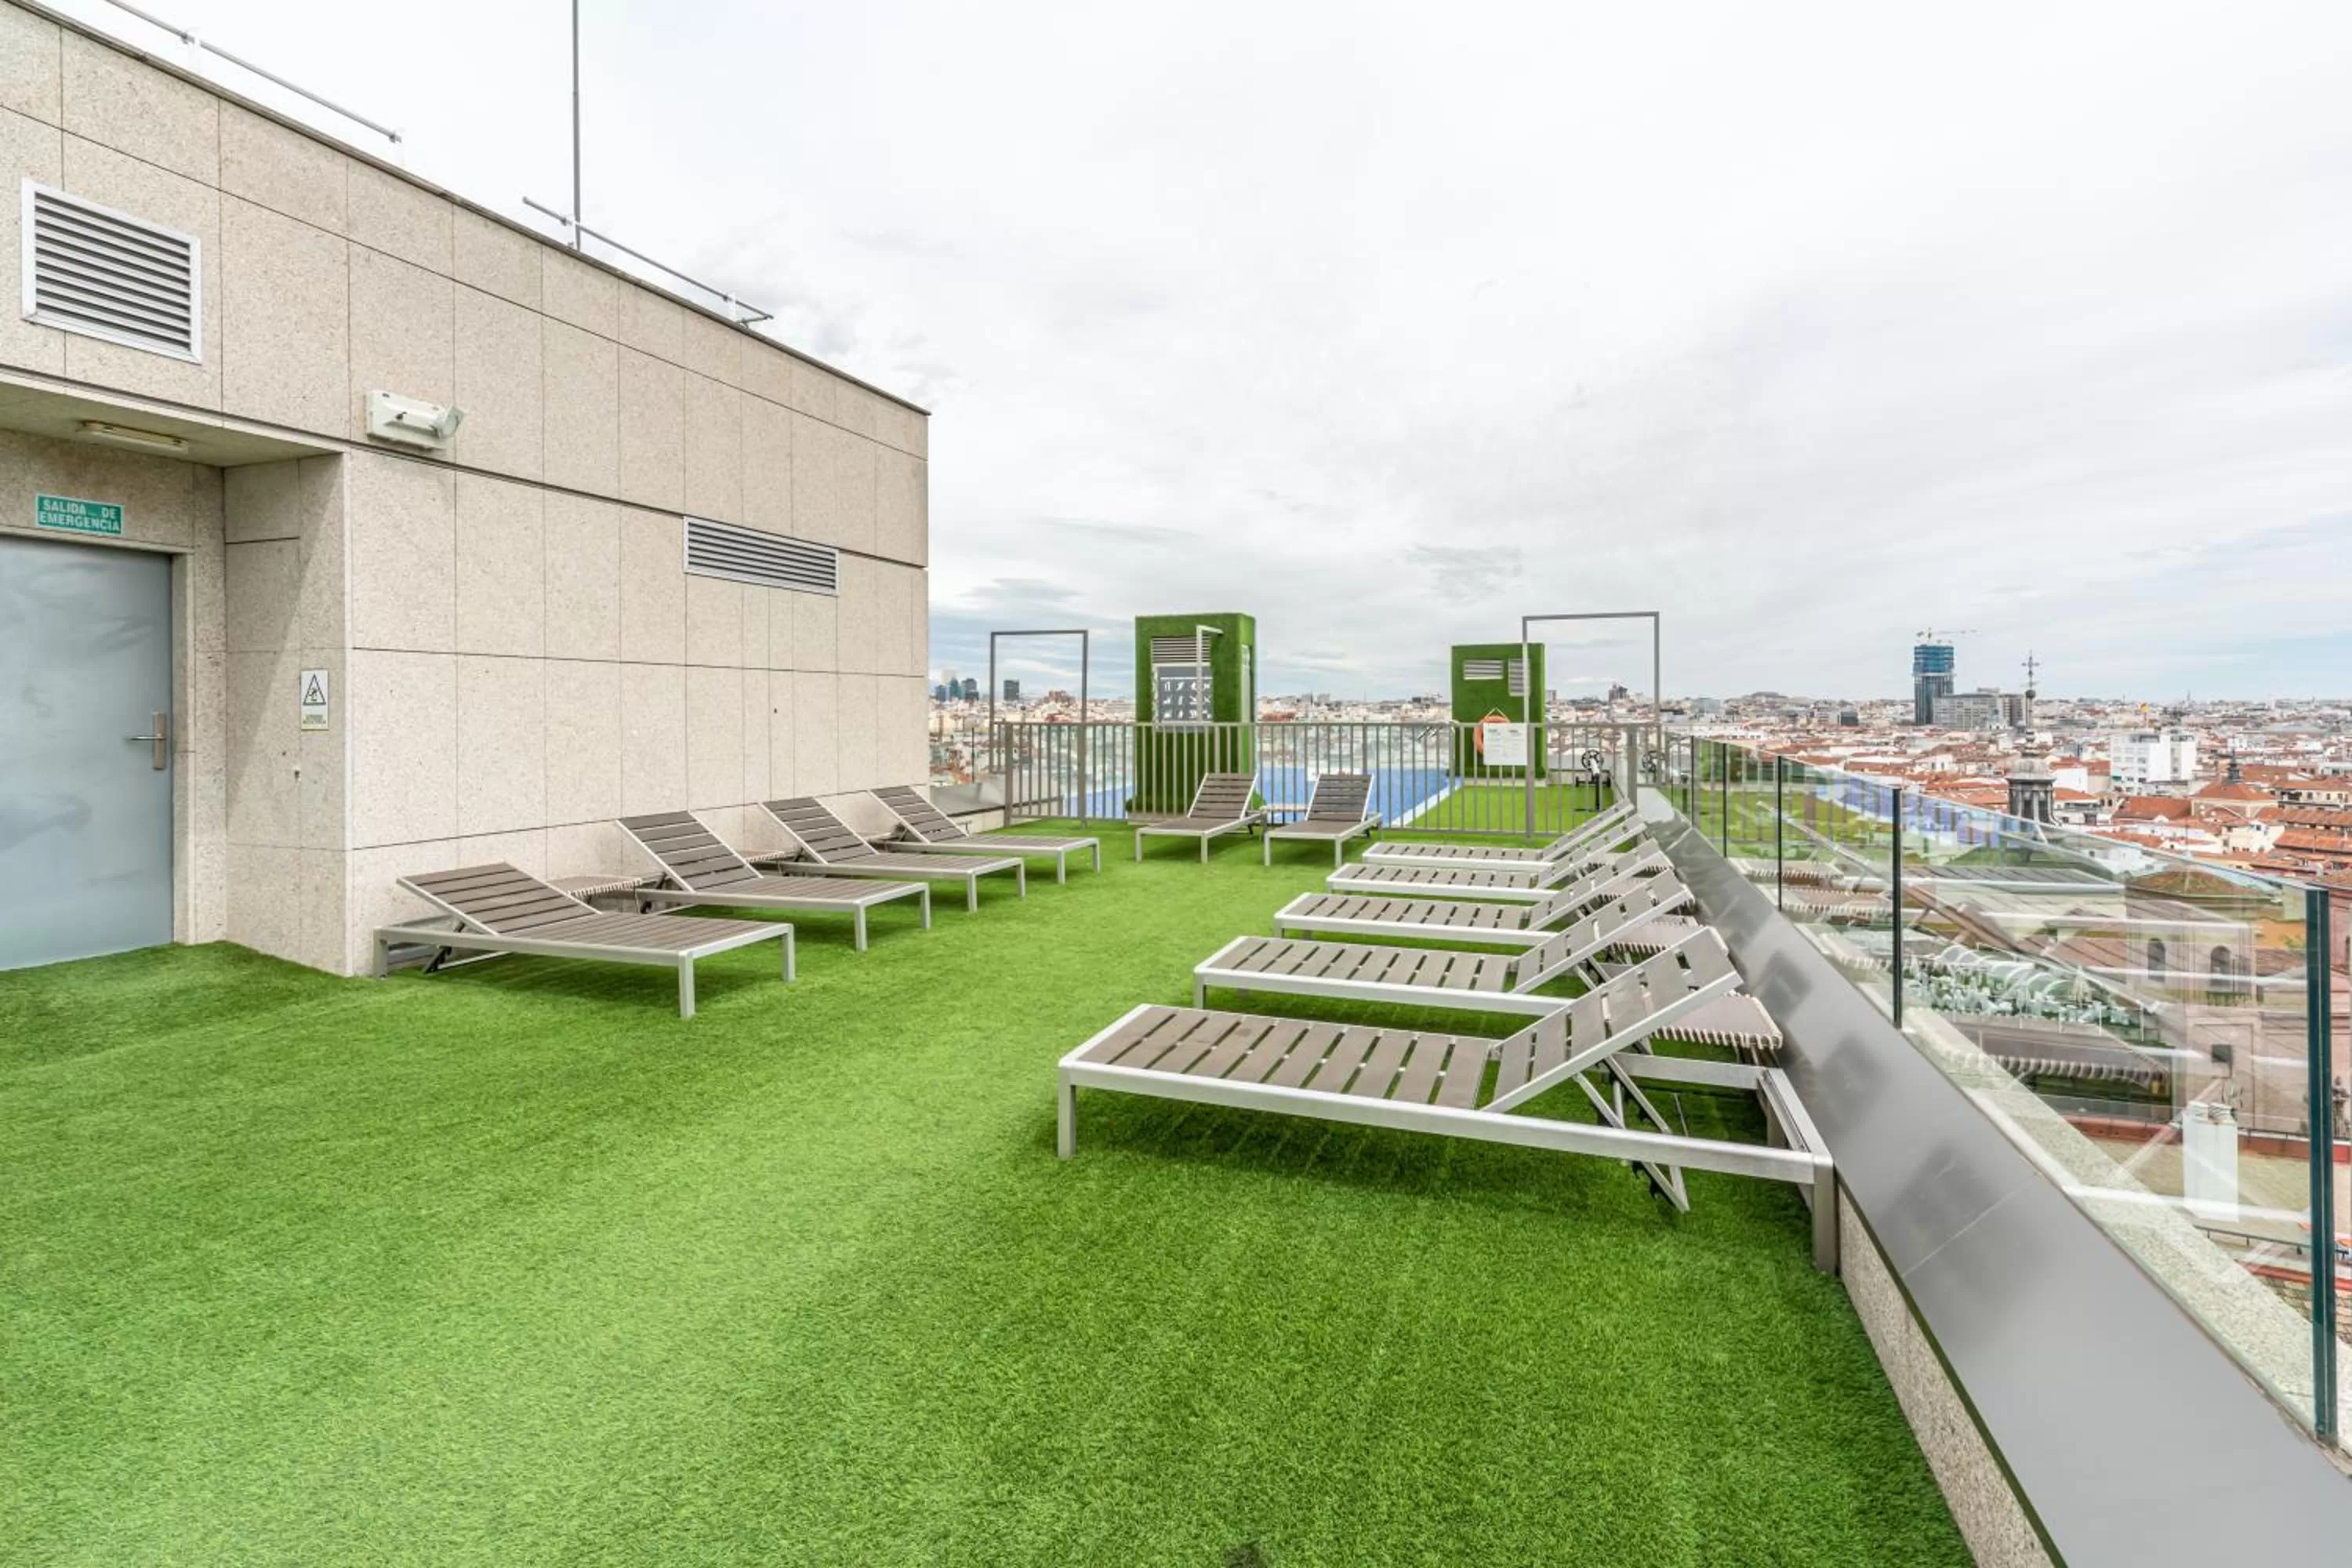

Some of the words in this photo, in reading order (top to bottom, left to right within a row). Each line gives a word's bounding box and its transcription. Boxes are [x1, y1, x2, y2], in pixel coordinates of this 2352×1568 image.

[43, 499, 87, 514] SALIDA
[101, 507, 117, 519] DE
[40, 512, 120, 532] EMERGENCIA
